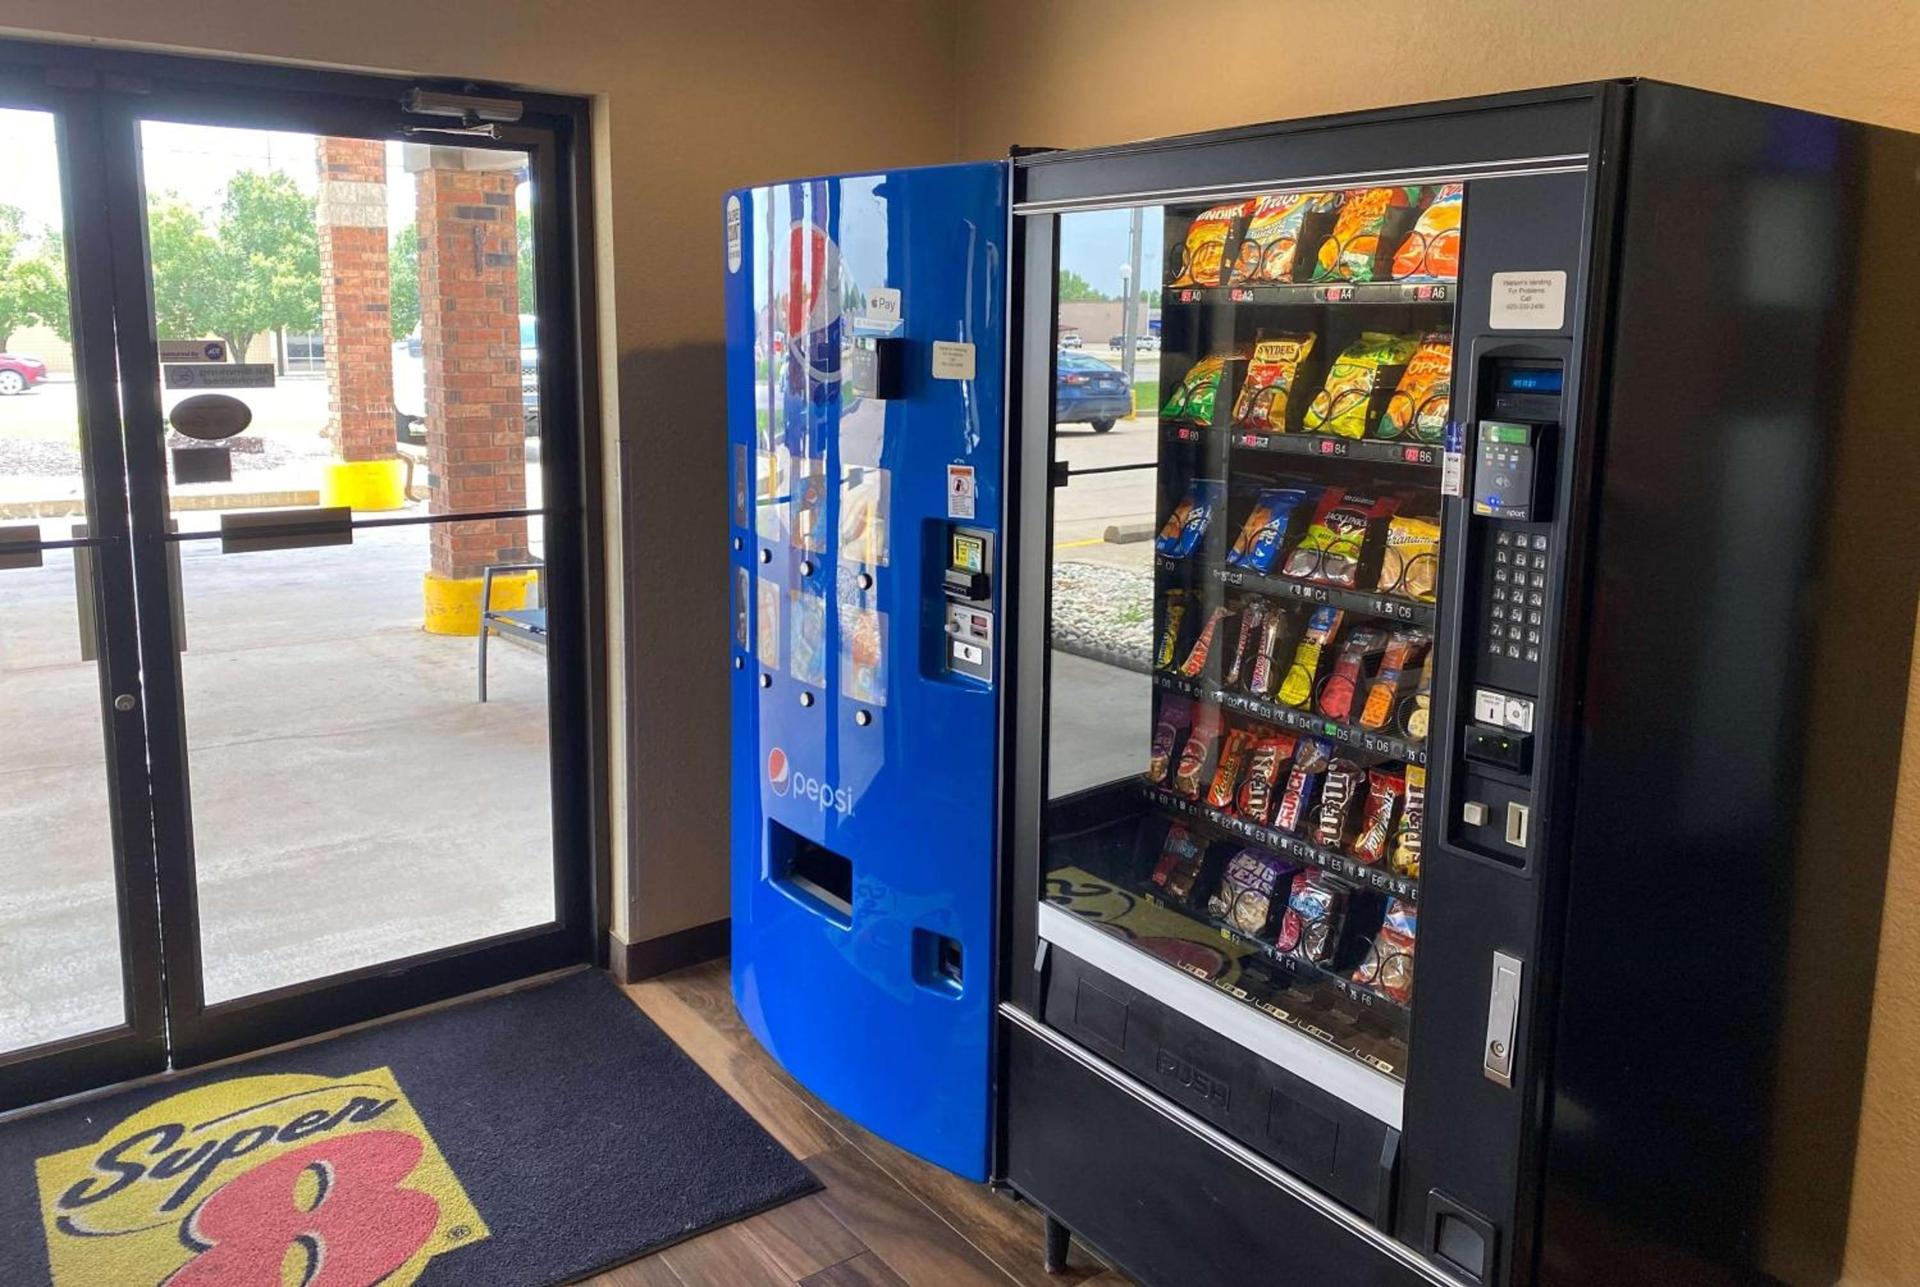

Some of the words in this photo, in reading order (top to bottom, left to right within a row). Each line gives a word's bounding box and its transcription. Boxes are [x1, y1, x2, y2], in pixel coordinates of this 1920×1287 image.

[1340, 286, 1352, 299] A4
[1432, 286, 1445, 299] A6
[879, 297, 895, 313] Pay
[1324, 511, 1342, 522] JACK
[1315, 589, 1327, 601] C4
[1398, 606, 1412, 618] C6
[793, 771, 853, 816] pepsi
[1279, 767, 1304, 829] CRUNCH
[1238, 853, 1276, 882] BIG
[1331, 860, 1342, 872] E5
[1227, 861, 1273, 895] TEXAS
[1285, 960, 1296, 972] F4
[1361, 994, 1372, 1006] F6
[1159, 1051, 1227, 1103] PUSH
[57, 1097, 398, 1213] Super
